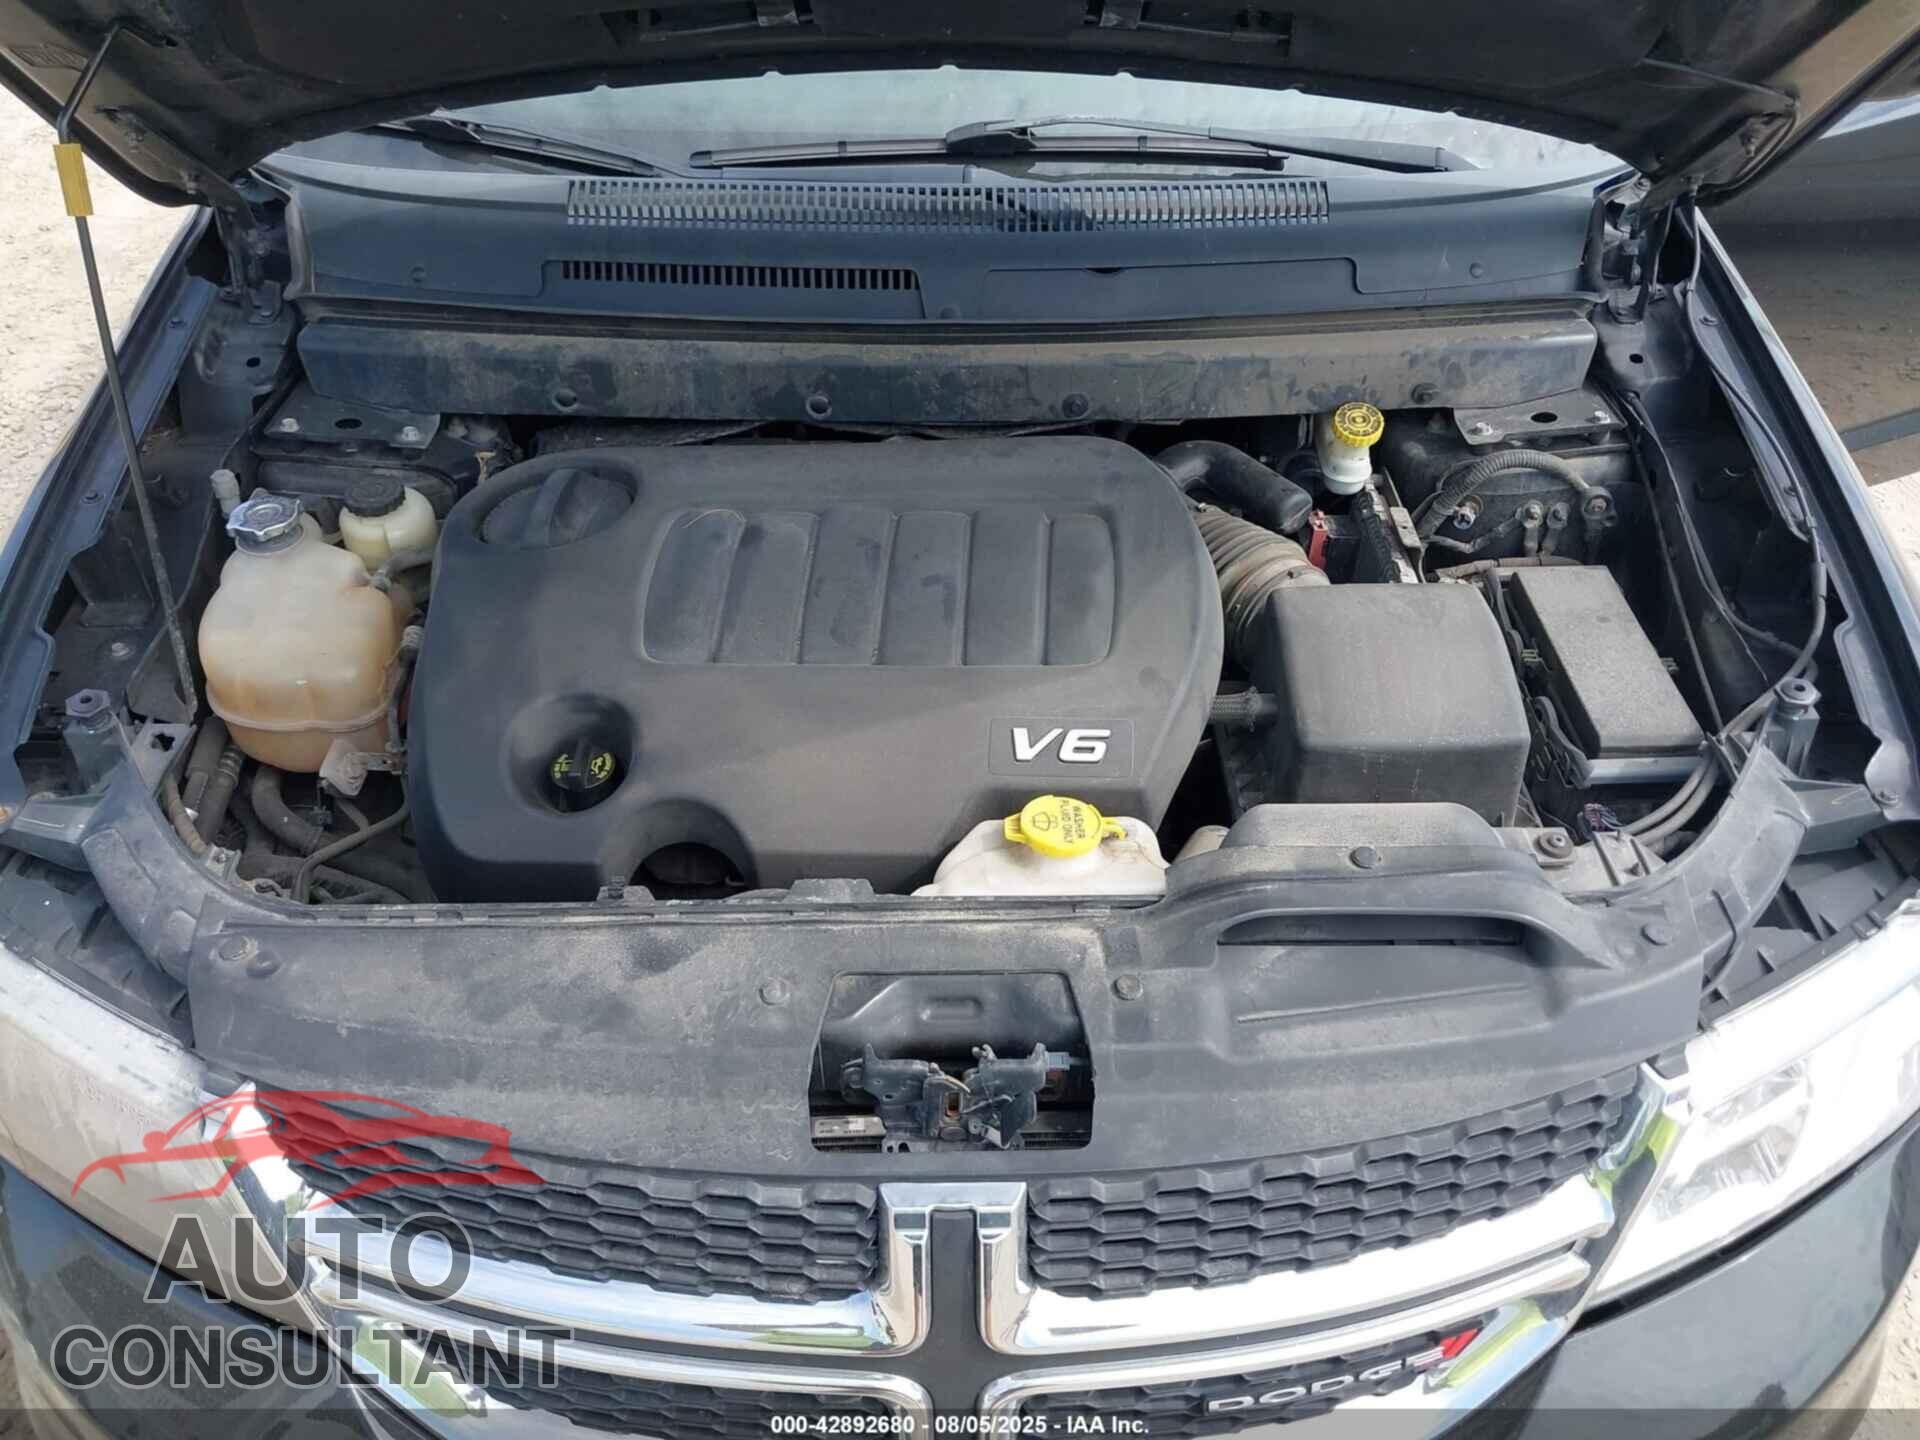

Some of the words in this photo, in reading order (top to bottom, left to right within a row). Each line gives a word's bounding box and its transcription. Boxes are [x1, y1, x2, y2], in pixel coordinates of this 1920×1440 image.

[1011, 727, 1111, 763] V6
[1072, 805, 1087, 839] WASHER
[1208, 1346, 1445, 1412] DODGE
